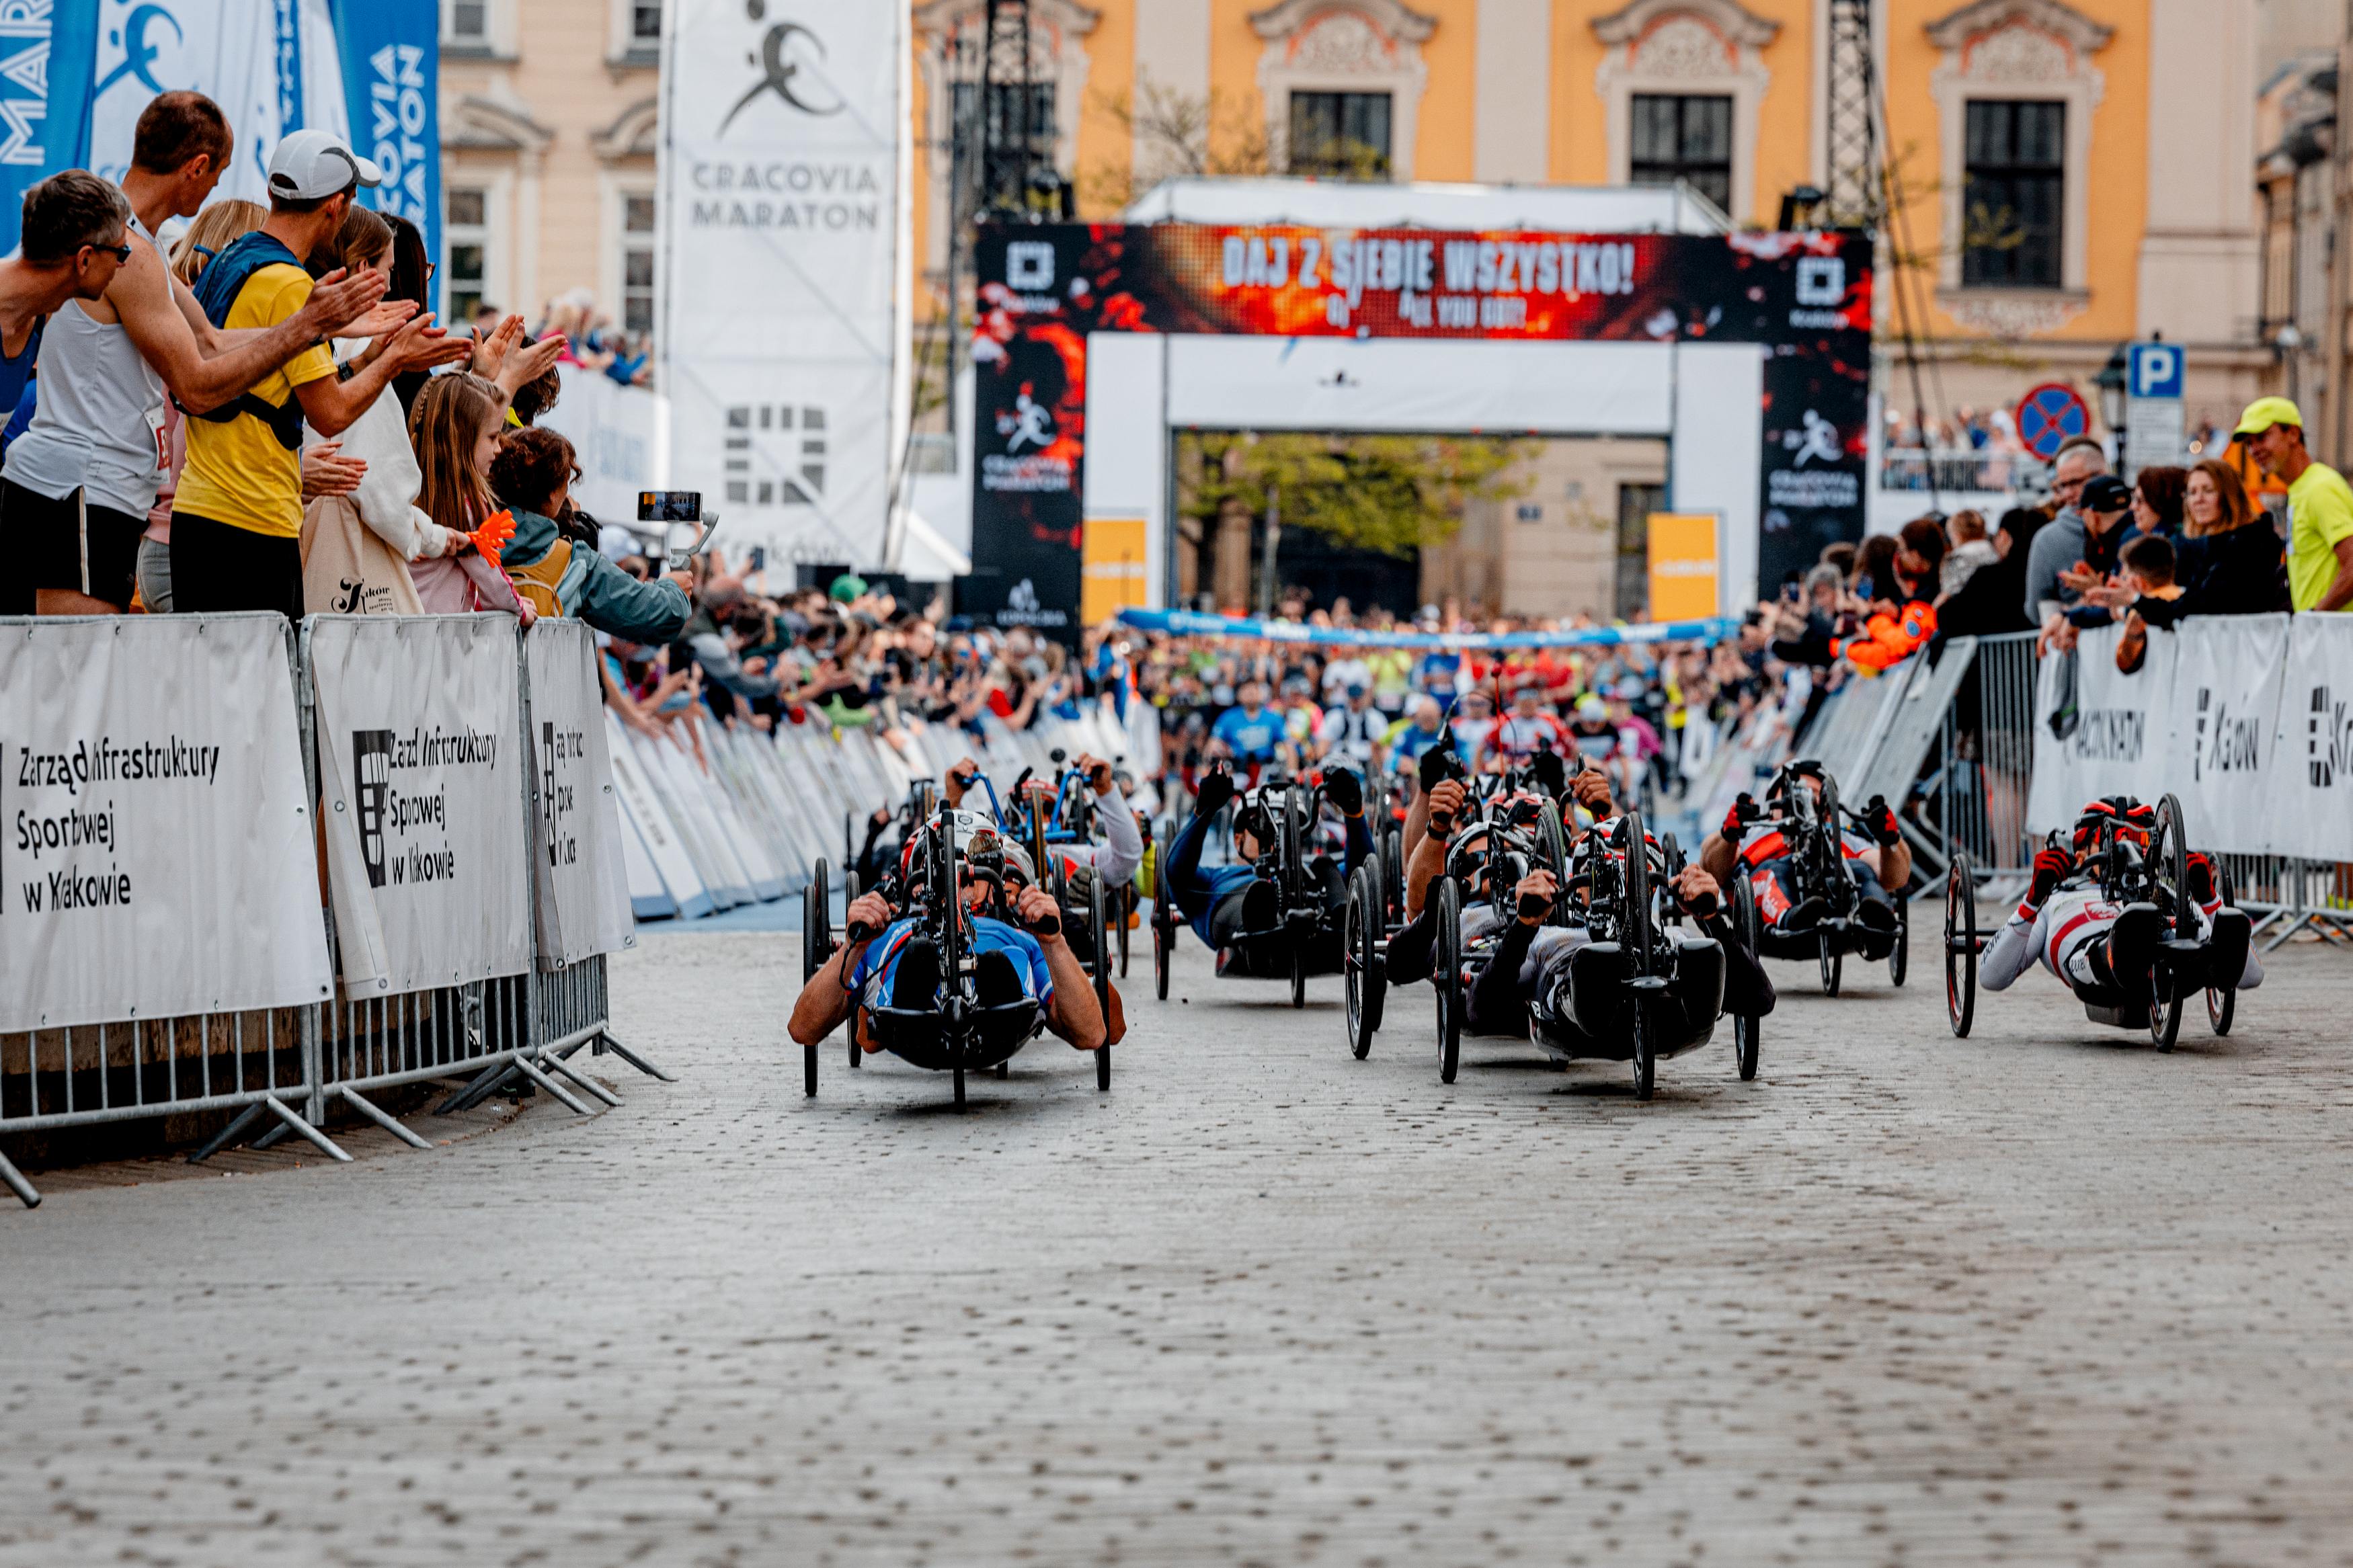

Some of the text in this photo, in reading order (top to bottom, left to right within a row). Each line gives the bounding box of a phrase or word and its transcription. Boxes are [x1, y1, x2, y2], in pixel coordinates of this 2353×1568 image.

[692, 161, 879, 192] CRACOVIA
[692, 202, 878, 230] MARATON
[1223, 237, 1288, 287] DAJ
[1299, 239, 1322, 288] Z
[1444, 241, 1635, 294] WSZYSTKO!
[2140, 351, 2174, 395] P
[392, 856, 405, 886] w
[23, 882, 42, 913] w
